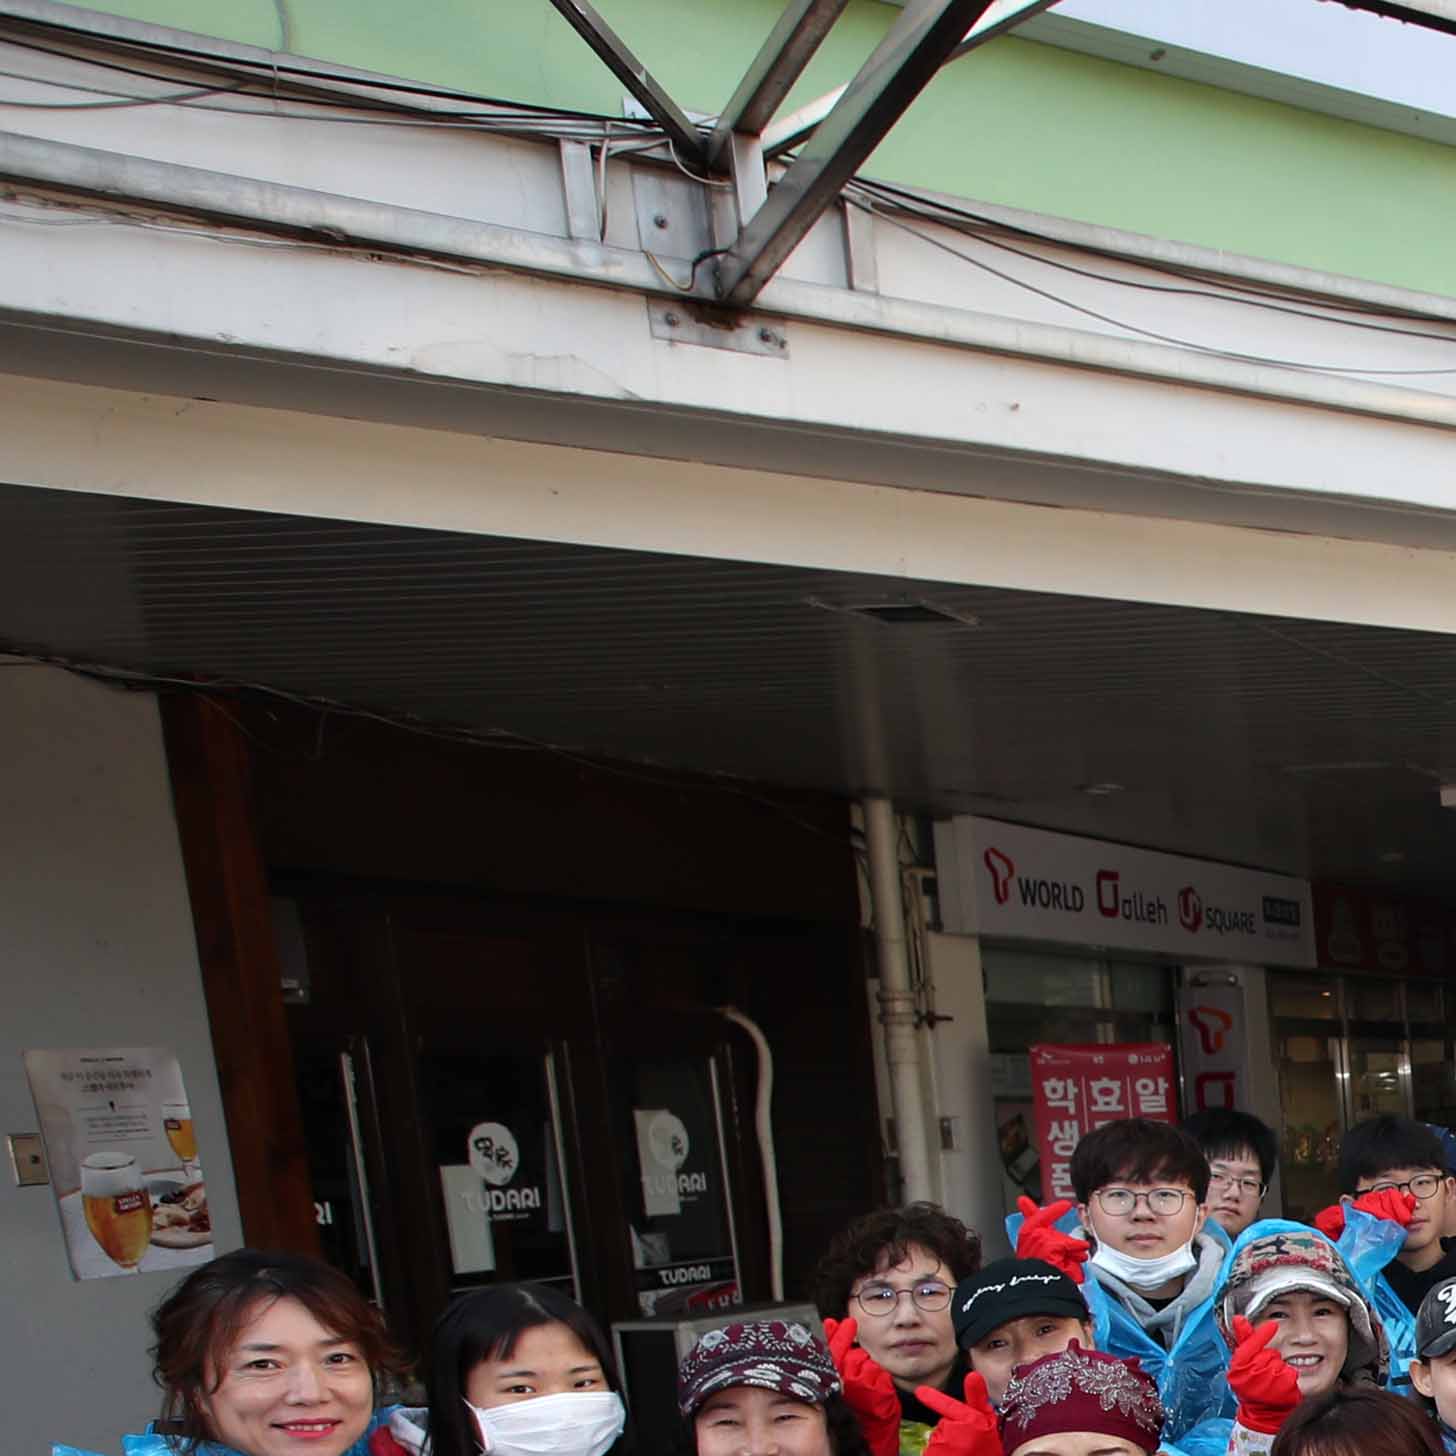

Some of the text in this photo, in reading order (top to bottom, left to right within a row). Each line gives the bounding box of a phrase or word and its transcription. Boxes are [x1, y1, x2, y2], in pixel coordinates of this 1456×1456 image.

[1017, 876, 1085, 914] WORLD
[1205, 906, 1257, 936] SQUARE
[643, 1171, 708, 1195] TUDARI
[461, 1186, 541, 1211] TUDARI
[658, 1263, 713, 1286] TUDARI
